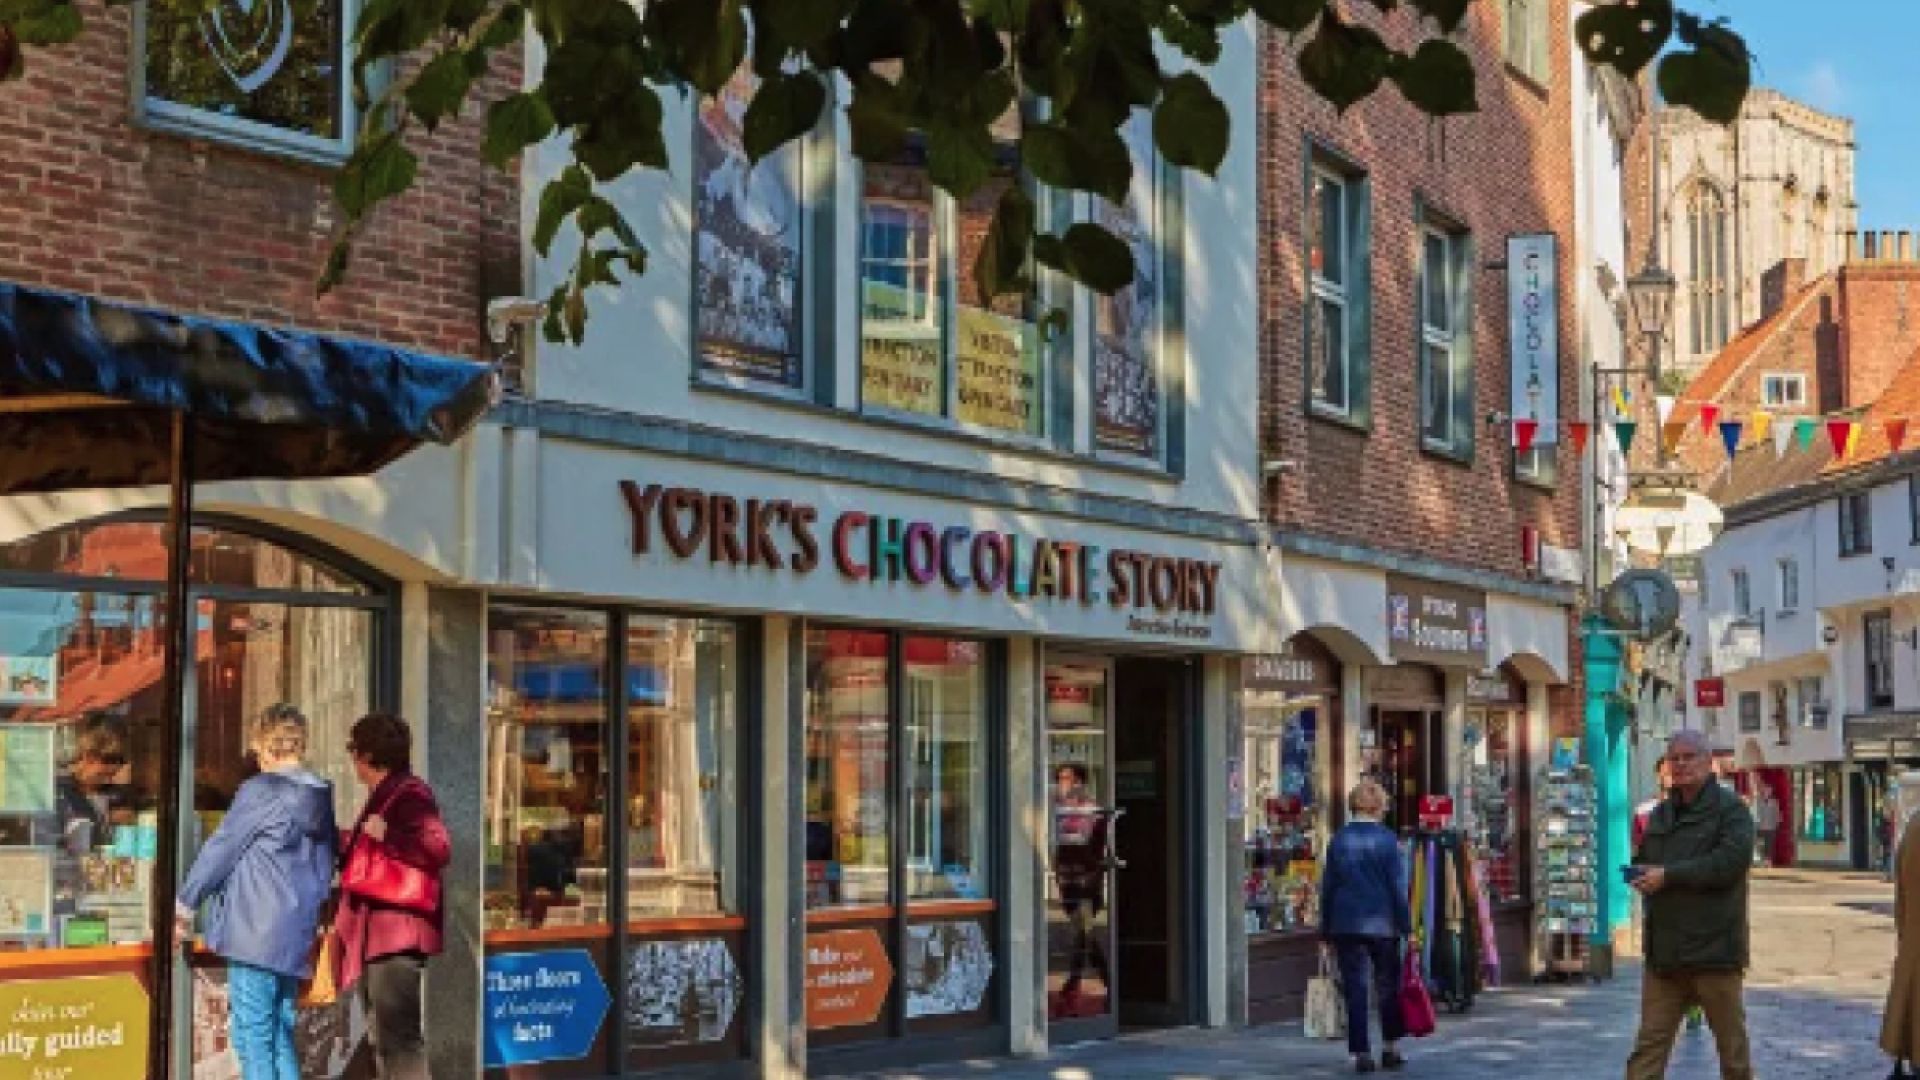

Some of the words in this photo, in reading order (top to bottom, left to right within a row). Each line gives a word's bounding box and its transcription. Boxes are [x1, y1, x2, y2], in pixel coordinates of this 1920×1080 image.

[617, 479, 818, 574] YORK'S
[831, 510, 1100, 607] CHOCOLATE
[1106, 548, 1222, 616] STORY
[45, 1020, 124, 1058] guided
